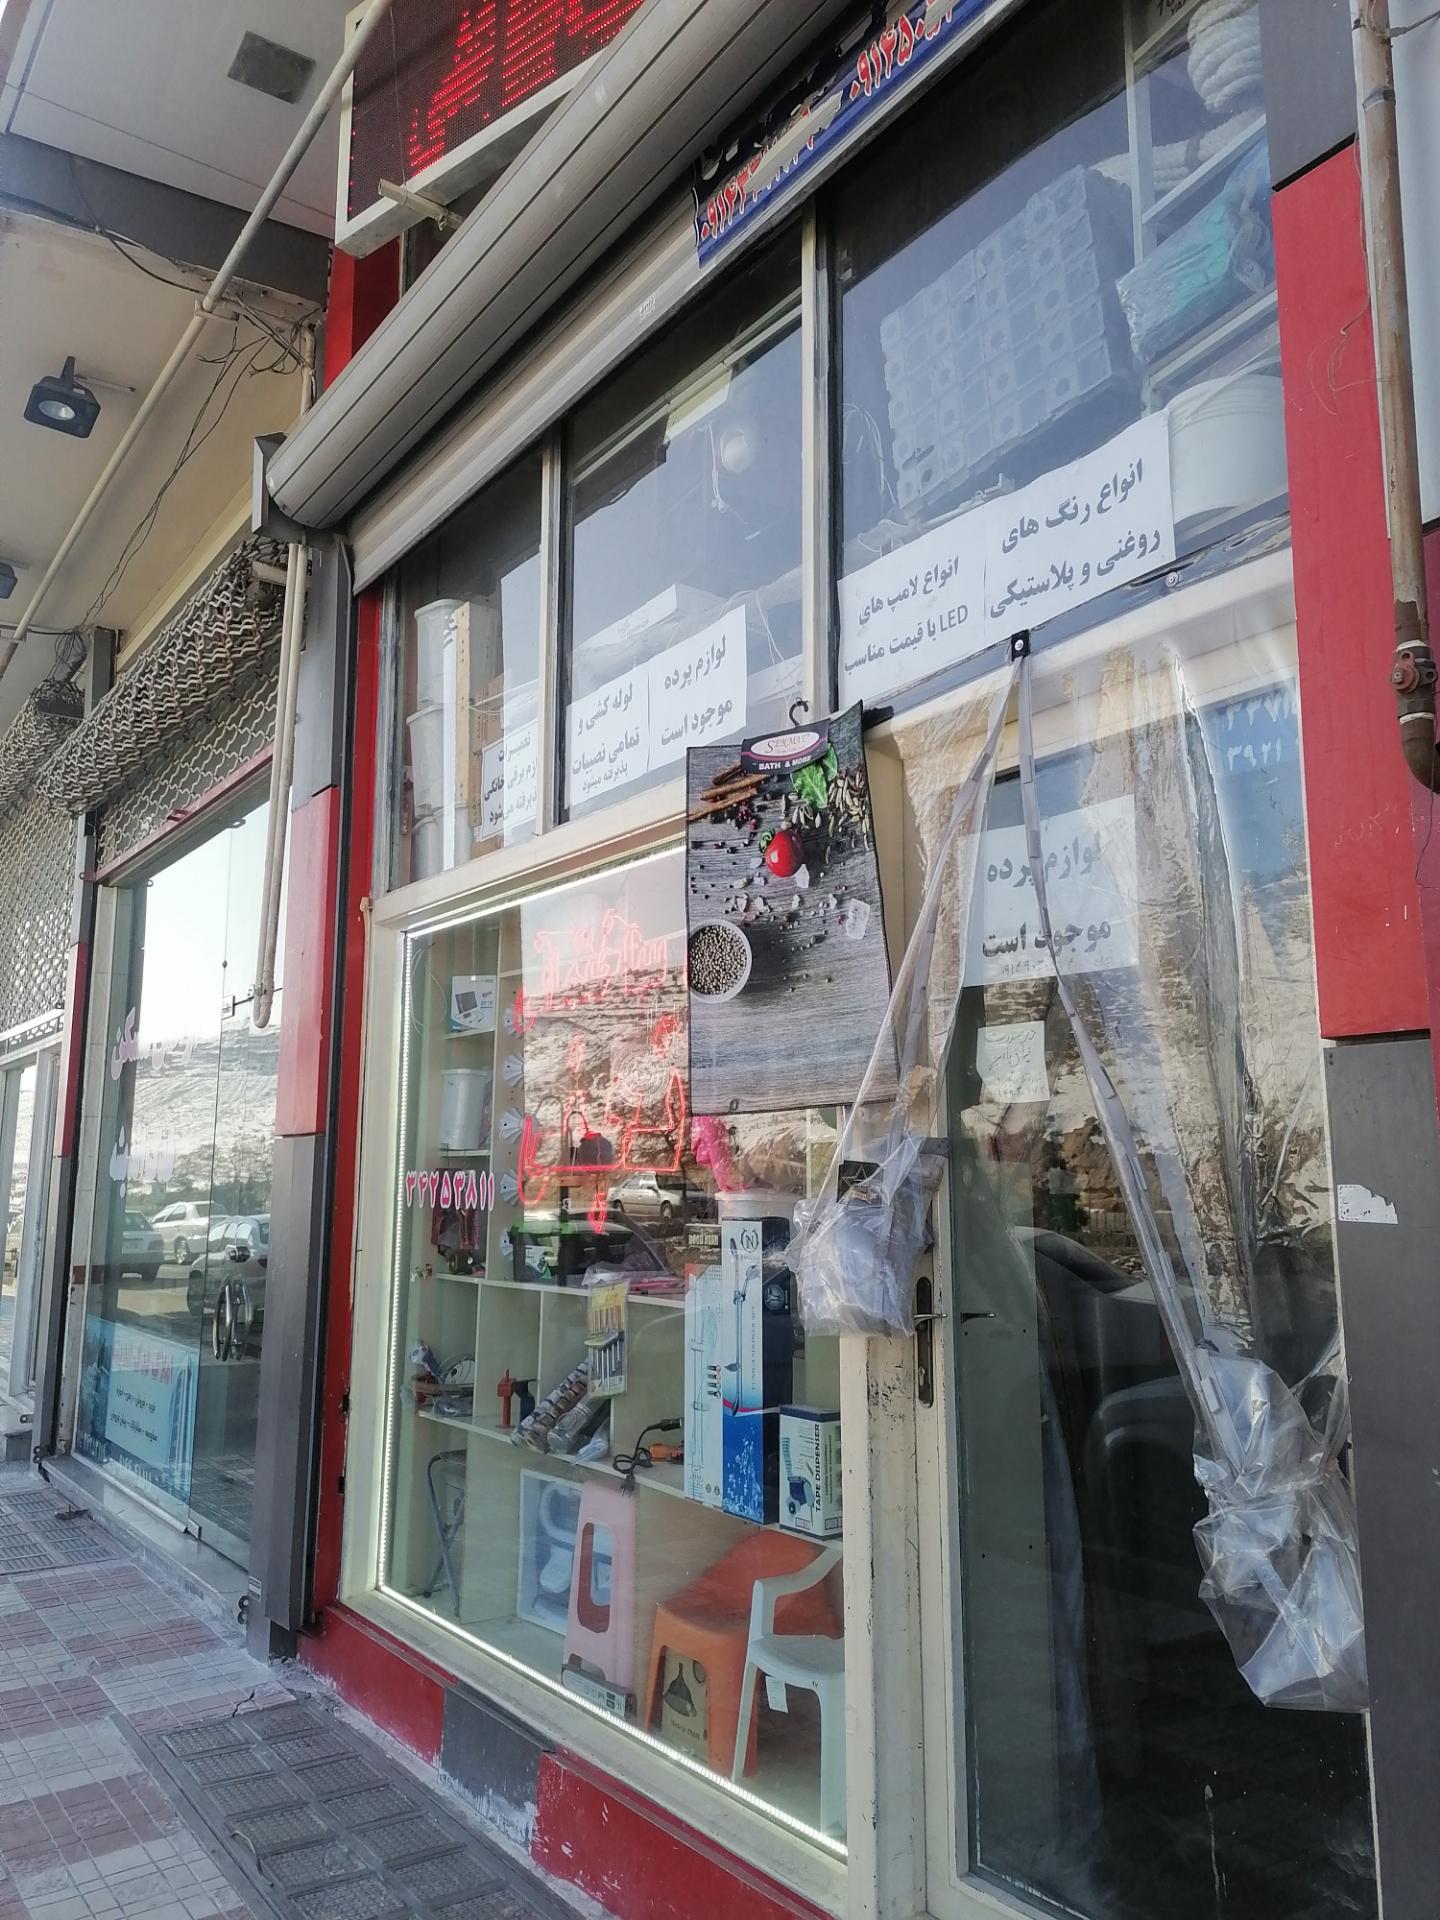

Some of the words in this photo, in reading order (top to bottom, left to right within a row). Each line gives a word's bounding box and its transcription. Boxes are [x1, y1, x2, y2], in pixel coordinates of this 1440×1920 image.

[1097, 458, 1144, 515] انواع
[1045, 495, 1091, 531] رنگ
[1001, 516, 1040, 555] های
[1096, 527, 1161, 577] روغنی
[922, 556, 959, 597] انواع
[989, 560, 1075, 619] پلاستیکی
[1080, 559, 1091, 585] و
[858, 597, 884, 627] های
[886, 575, 919, 616] لامپ
[926, 621, 937, 641] با
[939, 604, 969, 634] LED
[695, 635, 728, 680] لوازم
[843, 643, 885, 673] مناسب
[888, 624, 924, 658] قیمت
[664, 667, 693, 690] پرده
[585, 693, 610, 730] کشی
[612, 682, 634, 712] لوله
[577, 717, 585, 735] و
[661, 718, 688, 747] است
[691, 698, 733, 734] موجود
[608, 726, 641, 764] تمامی
[602, 763, 628, 786] پذیرفته
[759, 762, 781, 770] BATH
[982, 922, 1026, 957] است
[405, 1169, 495, 1212] ۳۴۲۵۳۸۱۱
